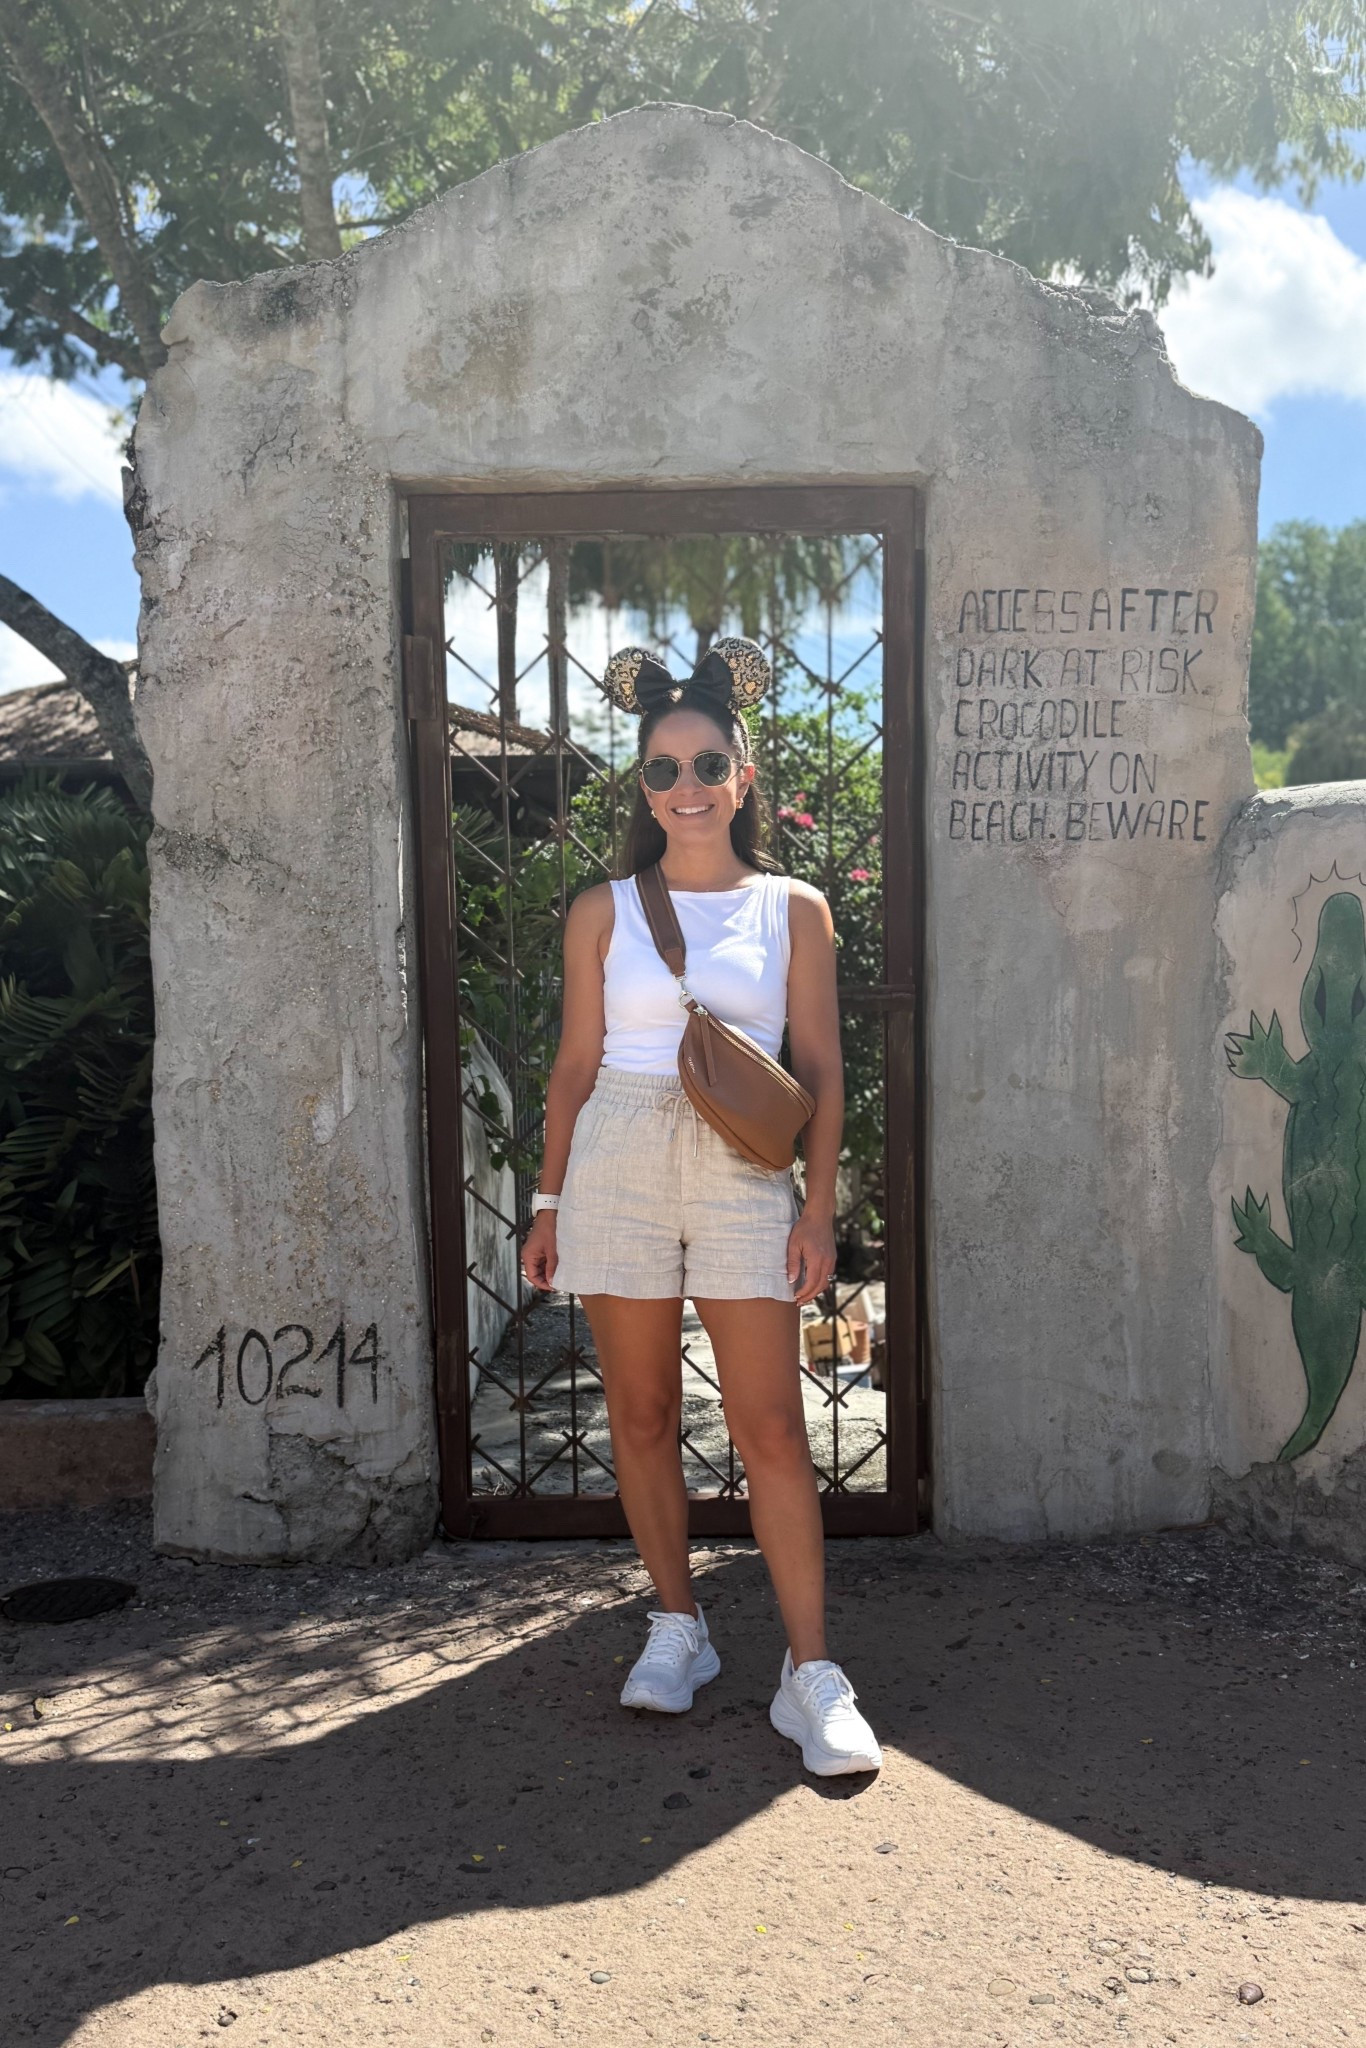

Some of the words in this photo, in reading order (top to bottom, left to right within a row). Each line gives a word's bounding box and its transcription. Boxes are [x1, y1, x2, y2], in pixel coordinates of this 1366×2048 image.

[958, 589, 1082, 633] ACCESS
[1088, 587, 1219, 633] AFTER
[956, 648, 1042, 689] DARK
[1060, 648, 1105, 687] AT
[954, 699, 1126, 740] CROCODILE
[952, 750, 1099, 793] ACTIVITY
[1110, 752, 1158, 794] ON
[1065, 800, 1209, 841] BEWARE
[191, 1320, 385, 1409] 10214
